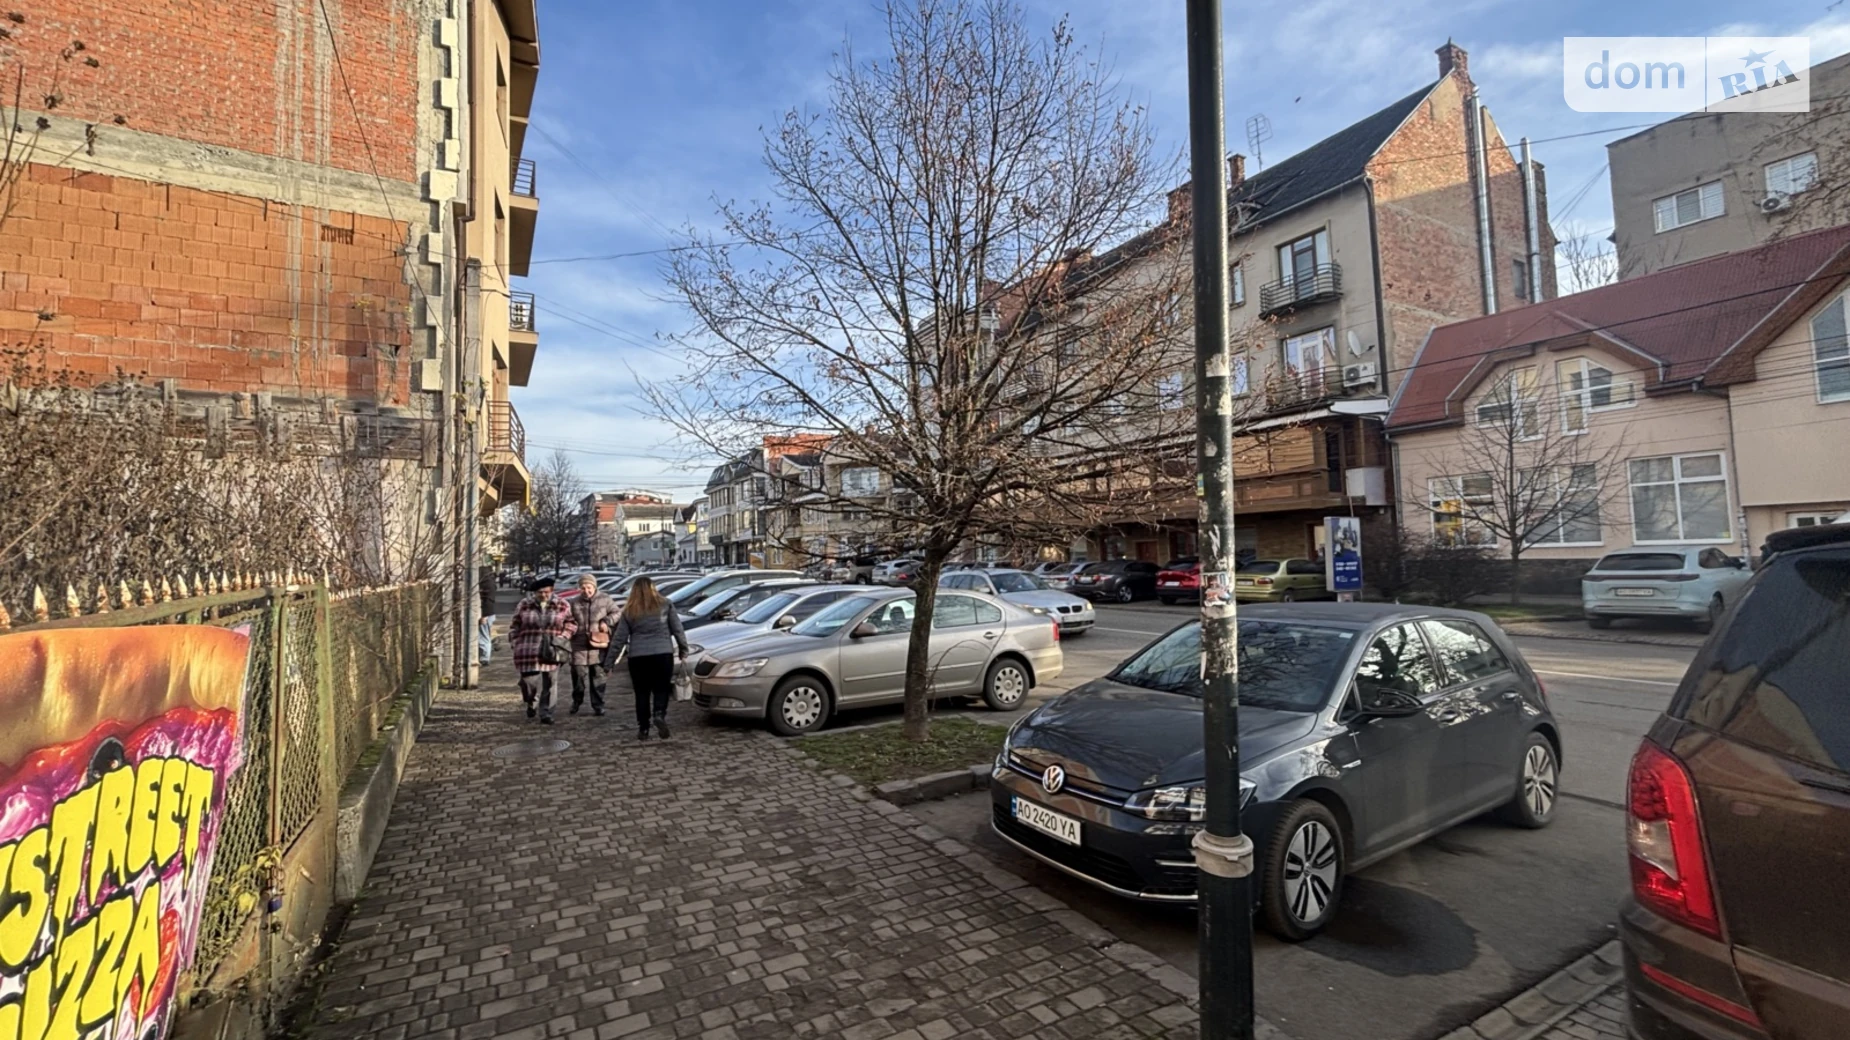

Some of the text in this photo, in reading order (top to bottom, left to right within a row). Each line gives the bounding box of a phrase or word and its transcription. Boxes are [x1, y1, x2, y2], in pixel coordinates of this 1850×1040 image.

[1018, 802, 1031, 819] AO
[1033, 809, 1057, 830] 2420
[1060, 818, 1076, 839] YA
[0, 882, 160, 1040] IZZA
